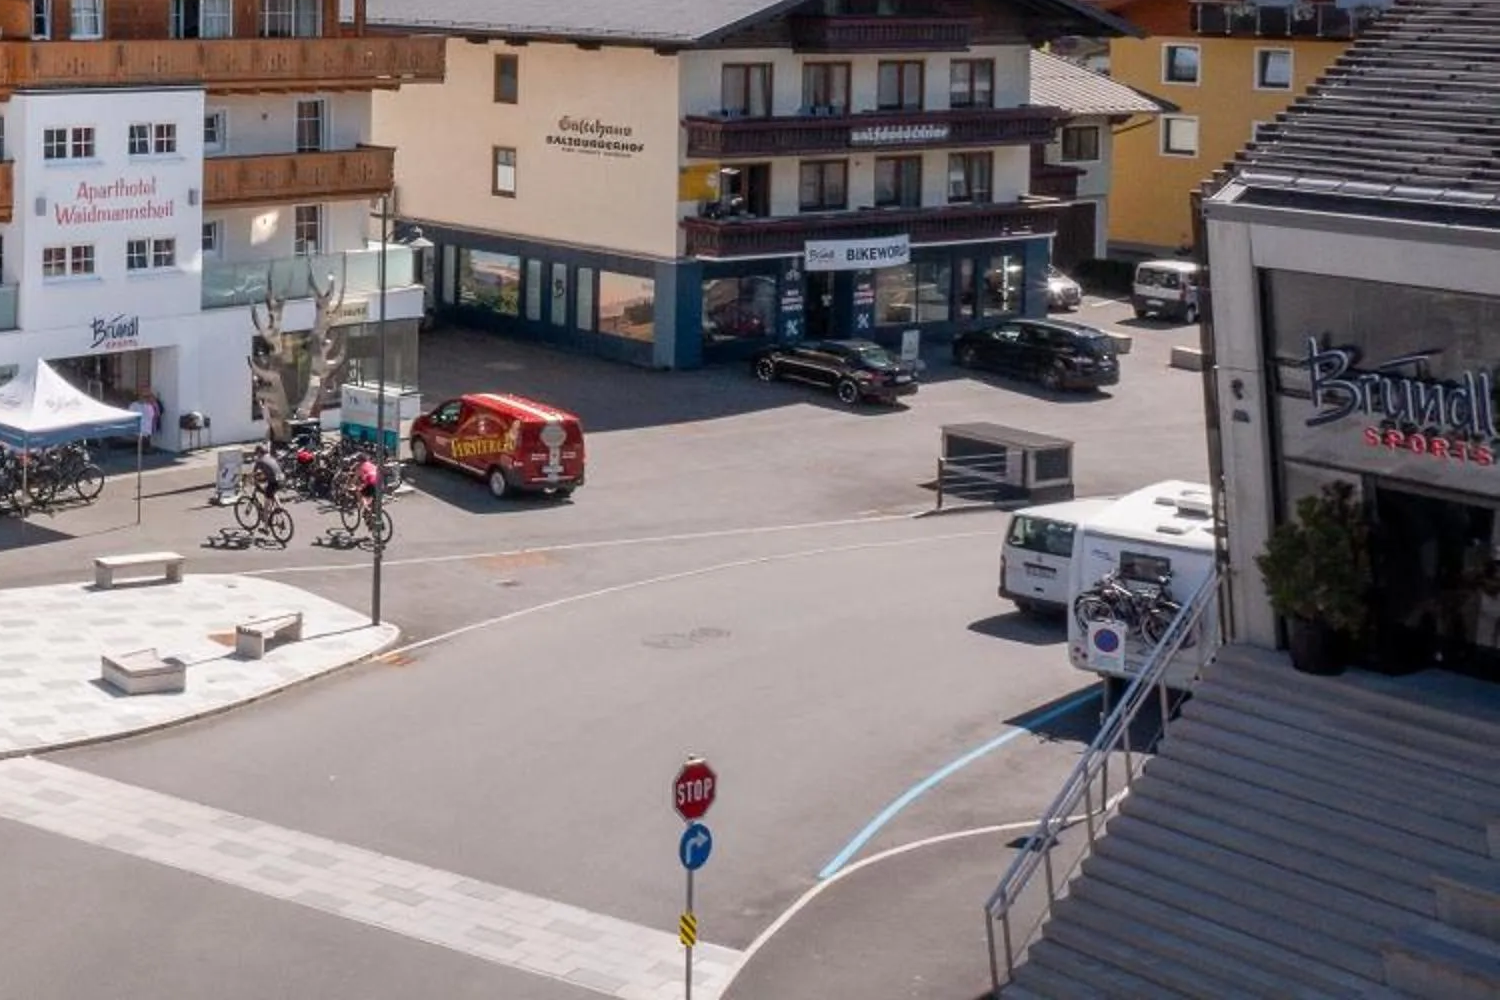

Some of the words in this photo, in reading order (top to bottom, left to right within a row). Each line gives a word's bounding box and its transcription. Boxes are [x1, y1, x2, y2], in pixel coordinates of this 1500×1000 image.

[76, 176, 156, 204] Aparthotel
[54, 199, 174, 225] Waidmannsheil
[1363, 425, 1495, 467] SPORTS
[677, 777, 713, 804] STOP
